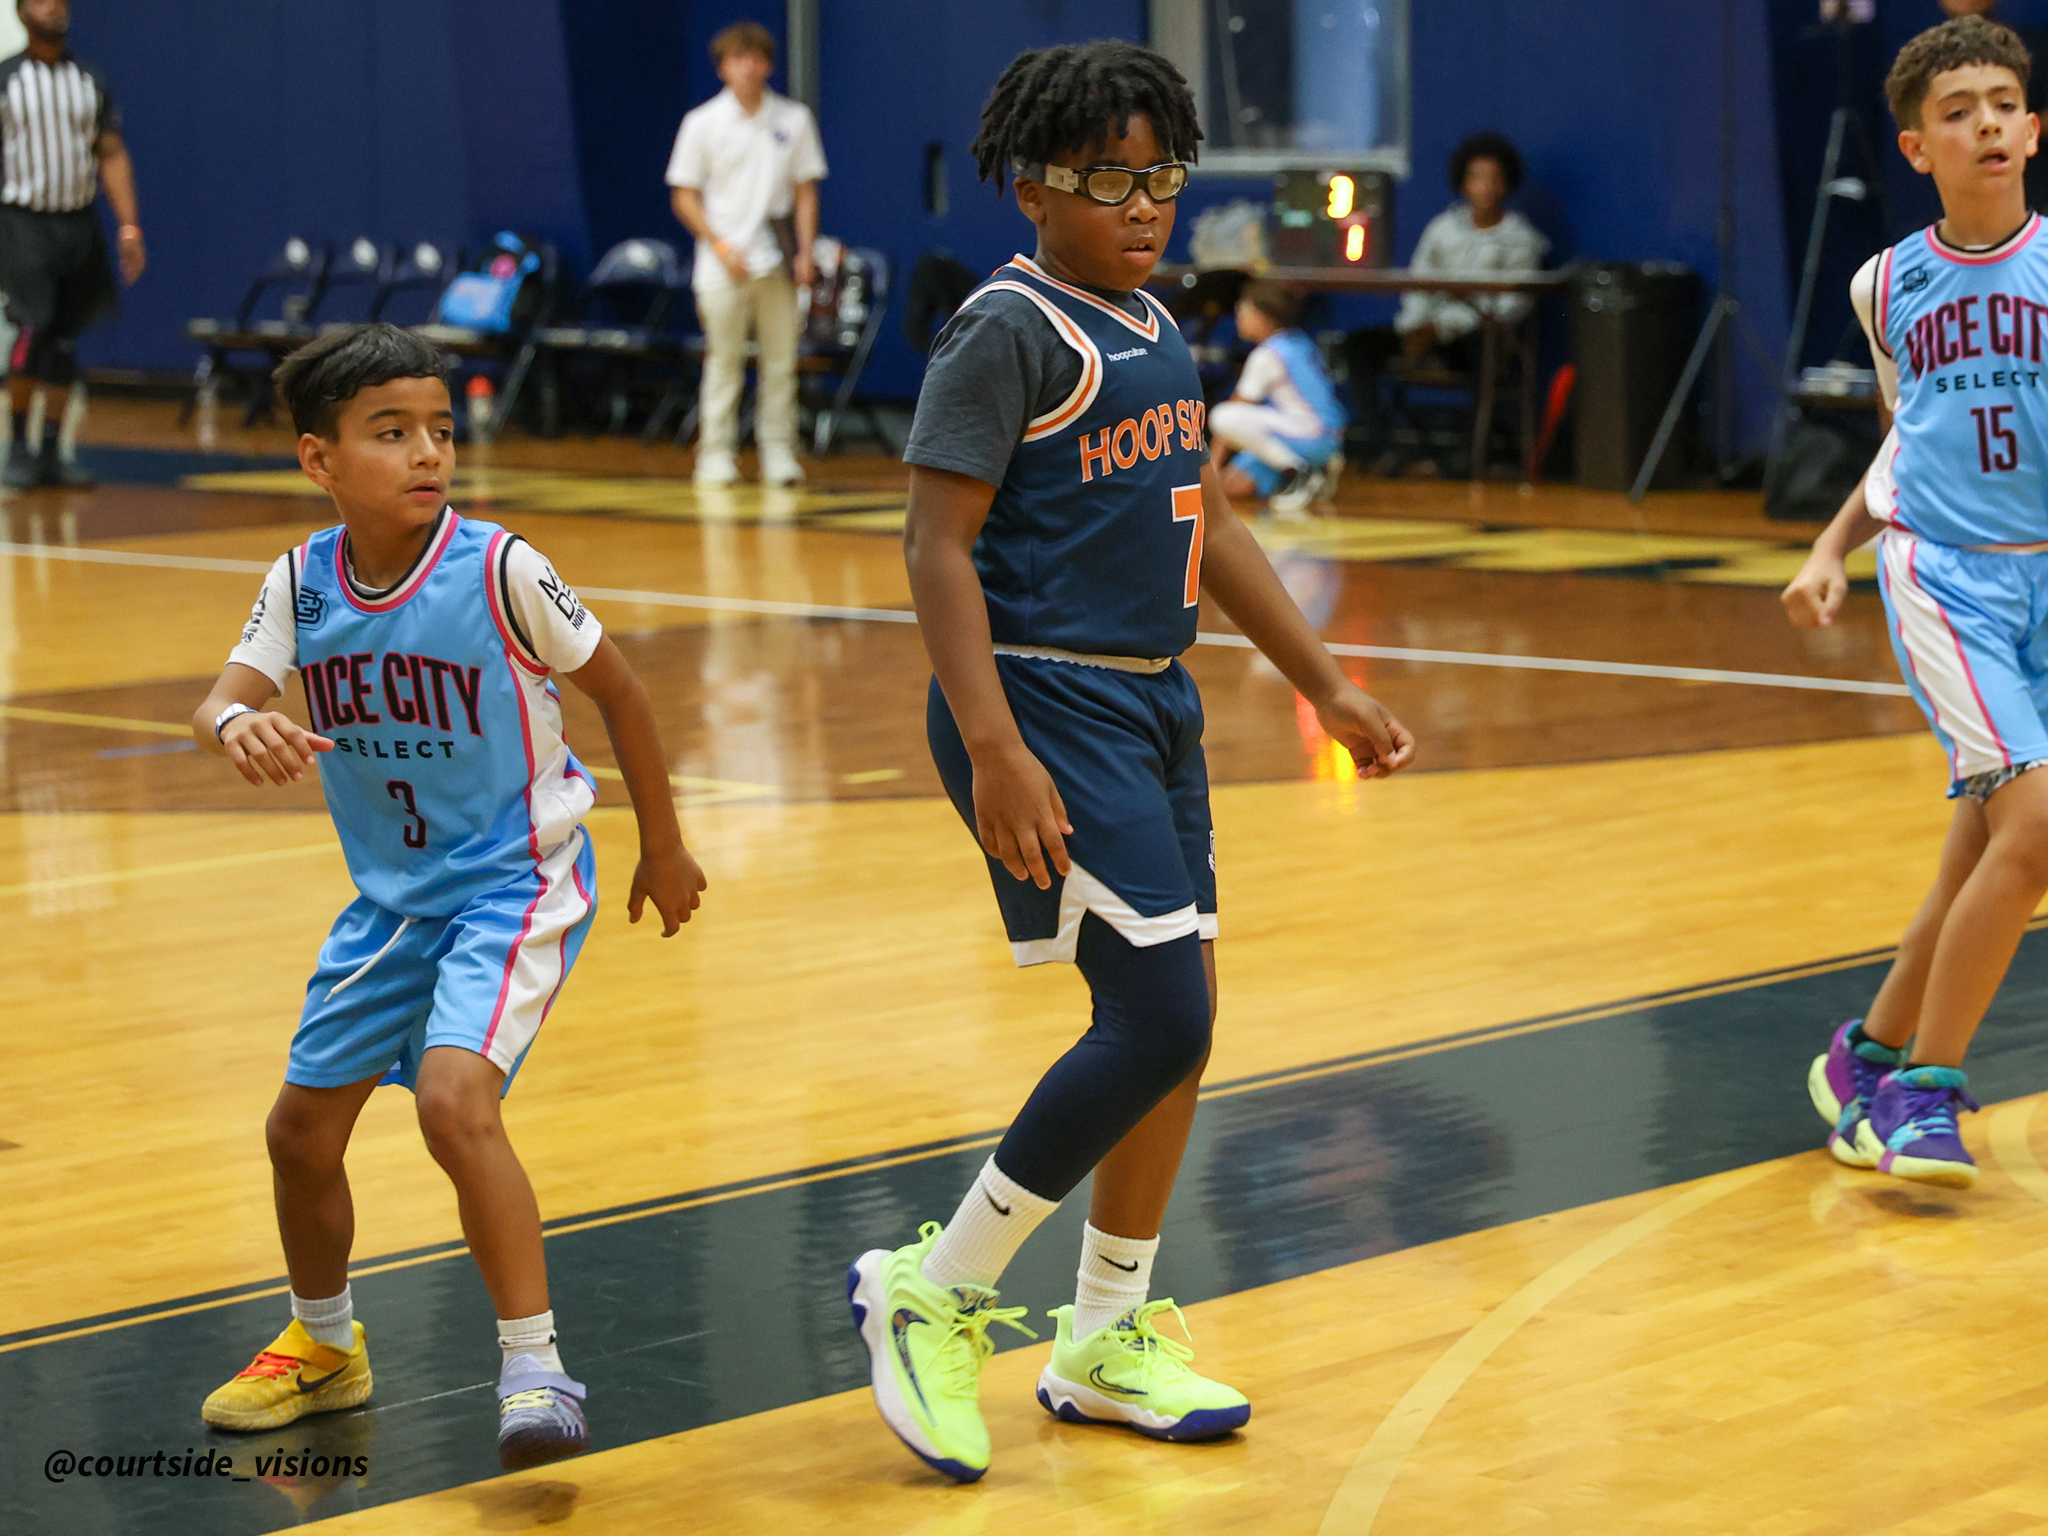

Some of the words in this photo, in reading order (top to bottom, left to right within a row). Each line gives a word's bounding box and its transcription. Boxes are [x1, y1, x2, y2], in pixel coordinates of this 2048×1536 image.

[1905, 294, 1982, 382] VICE
[1987, 293, 2048, 364] CIT
[1936, 371, 2040, 393] SELECT
[1078, 402, 1174, 483] HOOP
[1176, 399, 1206, 452] SK
[1970, 405, 2019, 473] 15
[1171, 483, 1205, 609] 7
[382, 651, 483, 738] CITY
[336, 737, 454, 759] SELECT
[386, 780, 427, 849] 3
